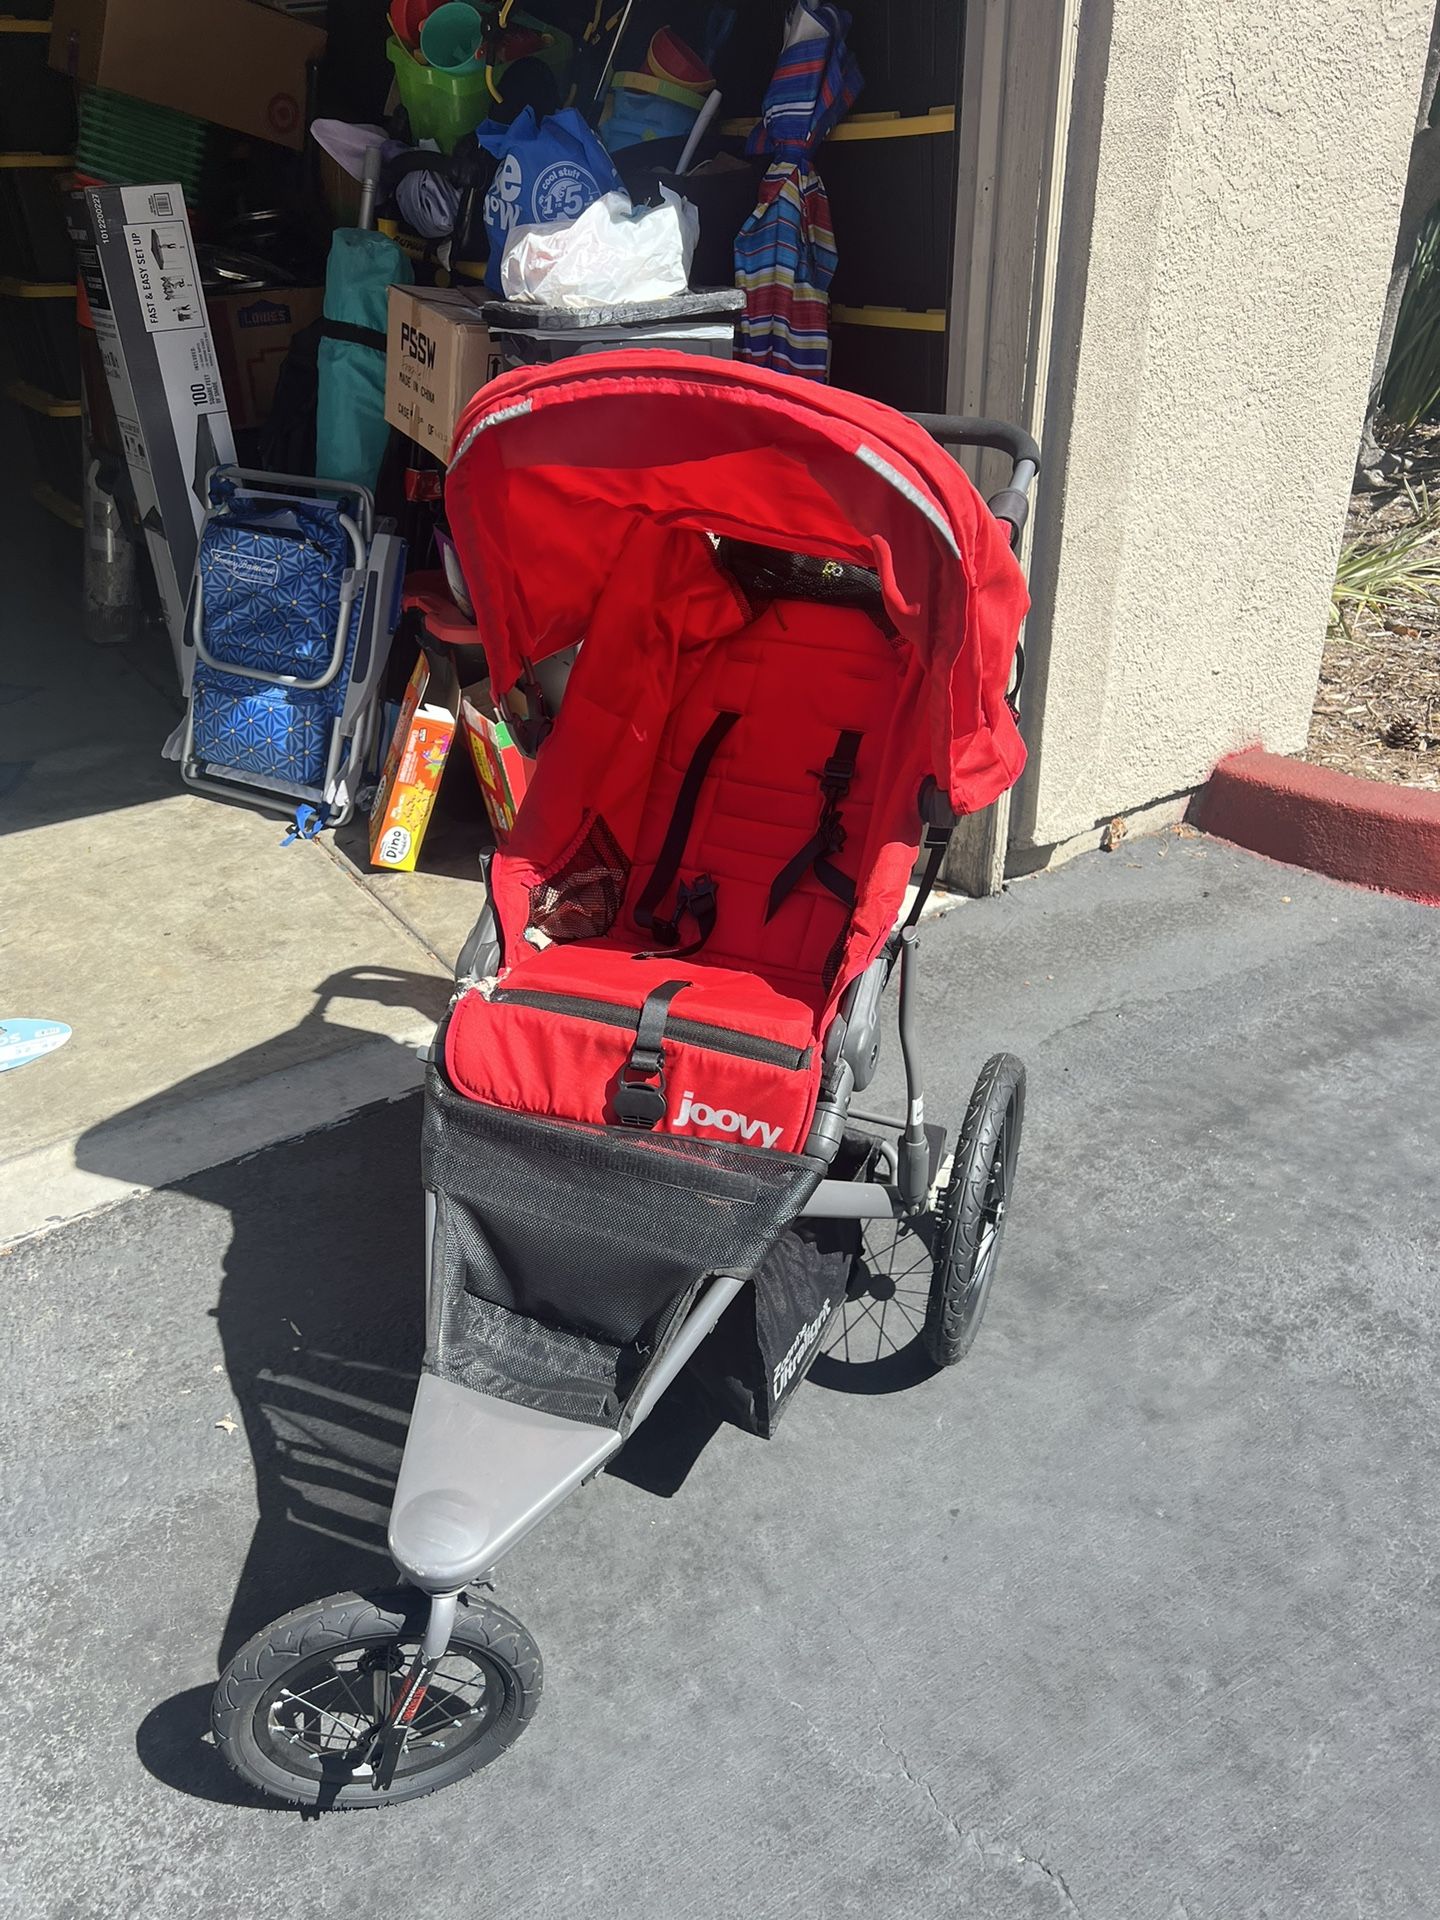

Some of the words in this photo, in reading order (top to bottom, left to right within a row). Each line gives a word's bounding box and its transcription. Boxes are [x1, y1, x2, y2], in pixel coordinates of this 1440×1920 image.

[541, 170, 558, 190] cool
[557, 167, 580, 179] stuff
[91, 193, 110, 244] 1012200227
[131, 233, 141, 245] UP
[135, 249, 146, 265] SET
[139, 267, 152, 290] EASY
[145, 292, 153, 300] &
[146, 303, 158, 324] FAST
[401, 322, 436, 370] PSSW
[190, 383, 208, 406] 100
[386, 830, 402, 859] Dino
[672, 1090, 784, 1148] joovy
